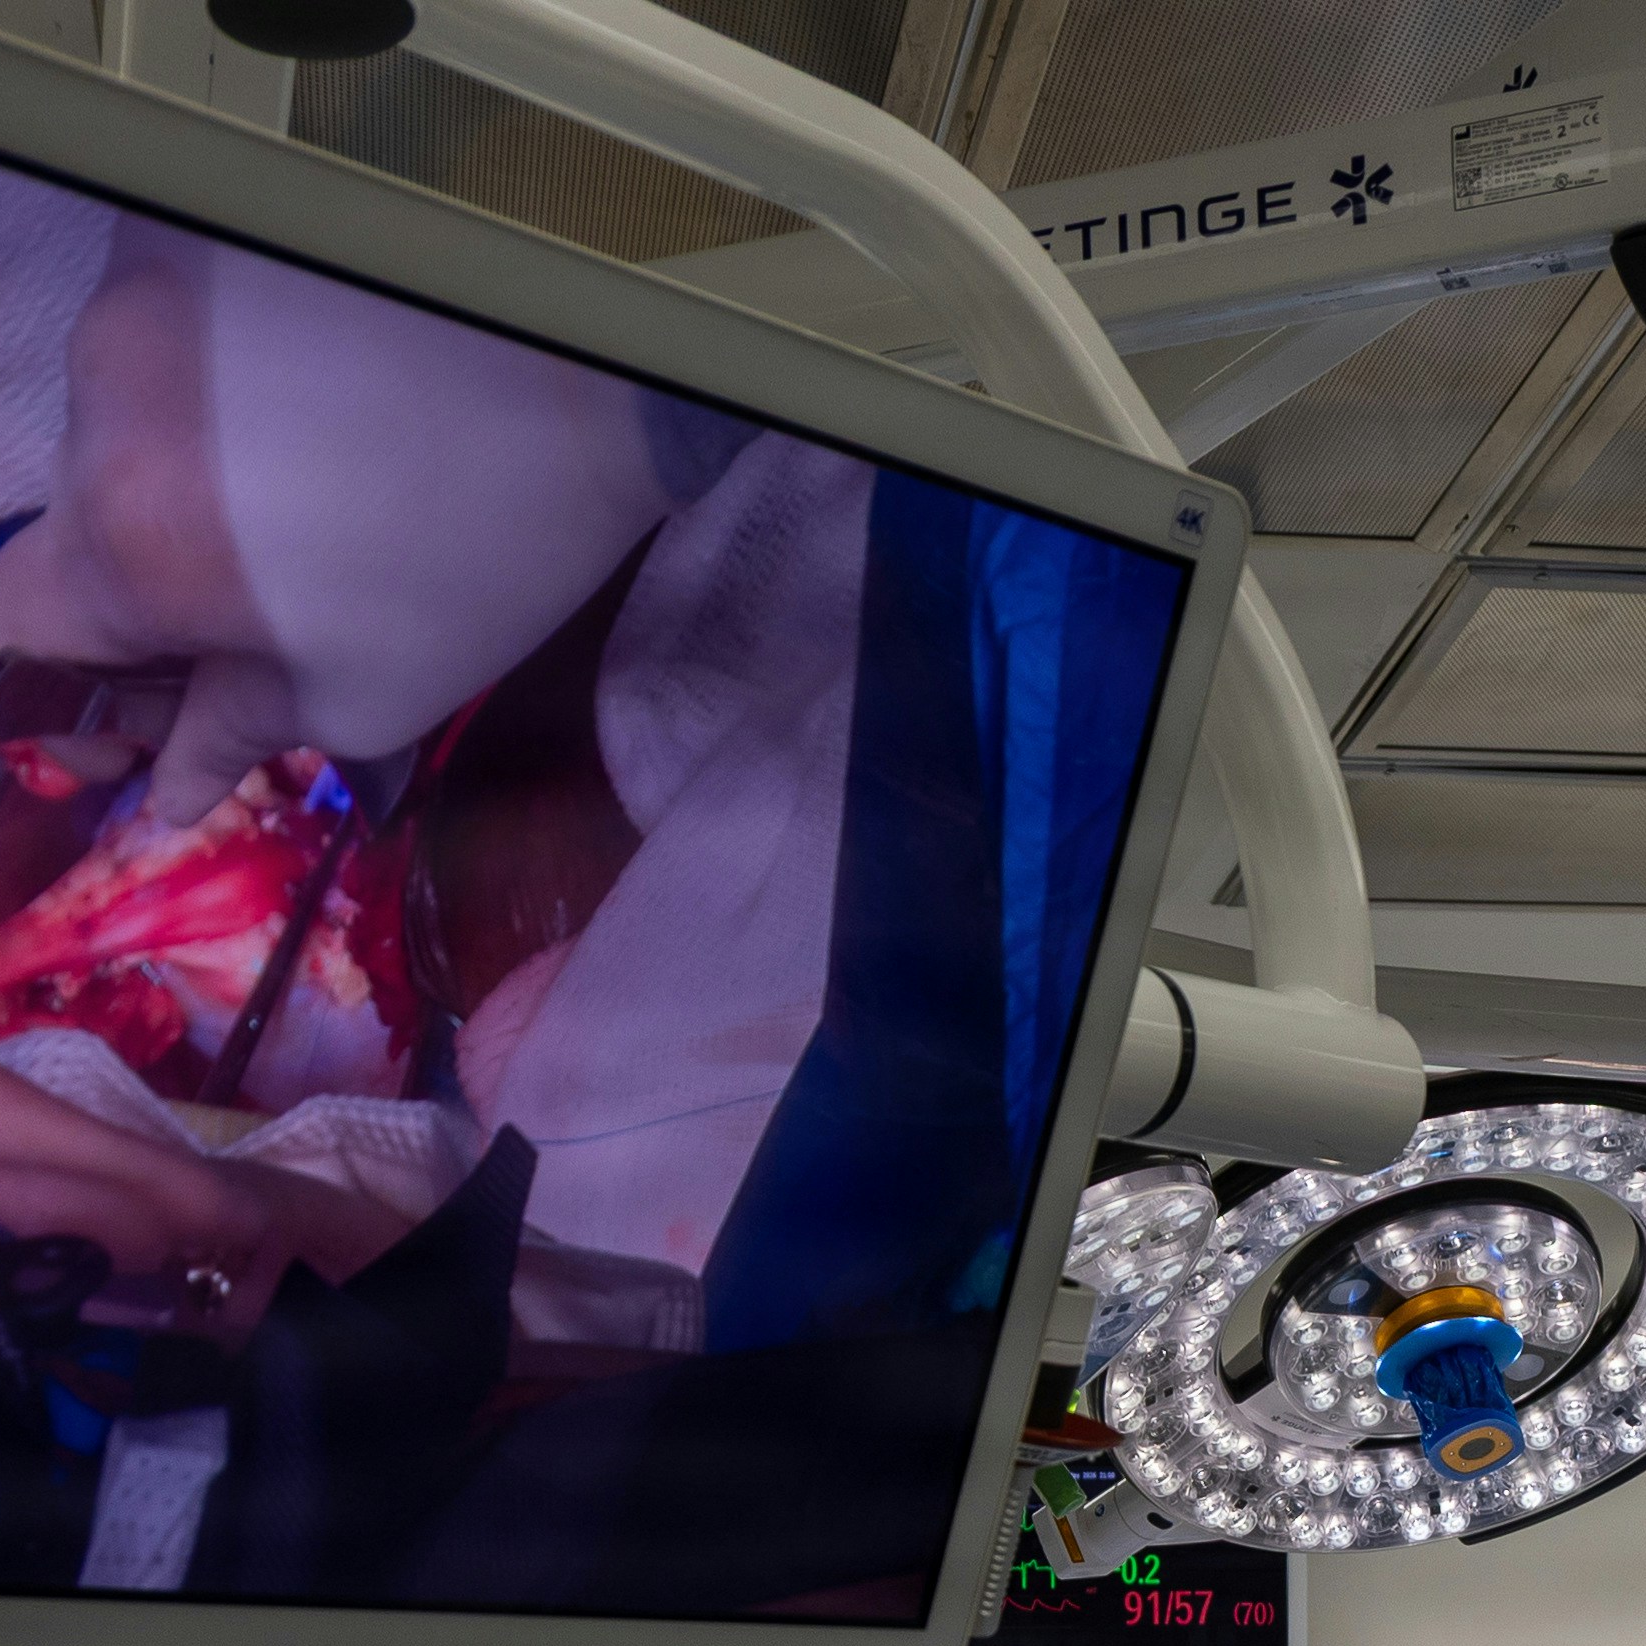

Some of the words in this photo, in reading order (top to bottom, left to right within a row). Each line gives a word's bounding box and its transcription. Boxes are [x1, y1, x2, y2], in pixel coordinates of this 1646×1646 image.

[1030, 180, 1297, 261] TINGE
[1124, 1590, 1214, 1626] 91/57
[1233, 1601, 1275, 1626] (70)
